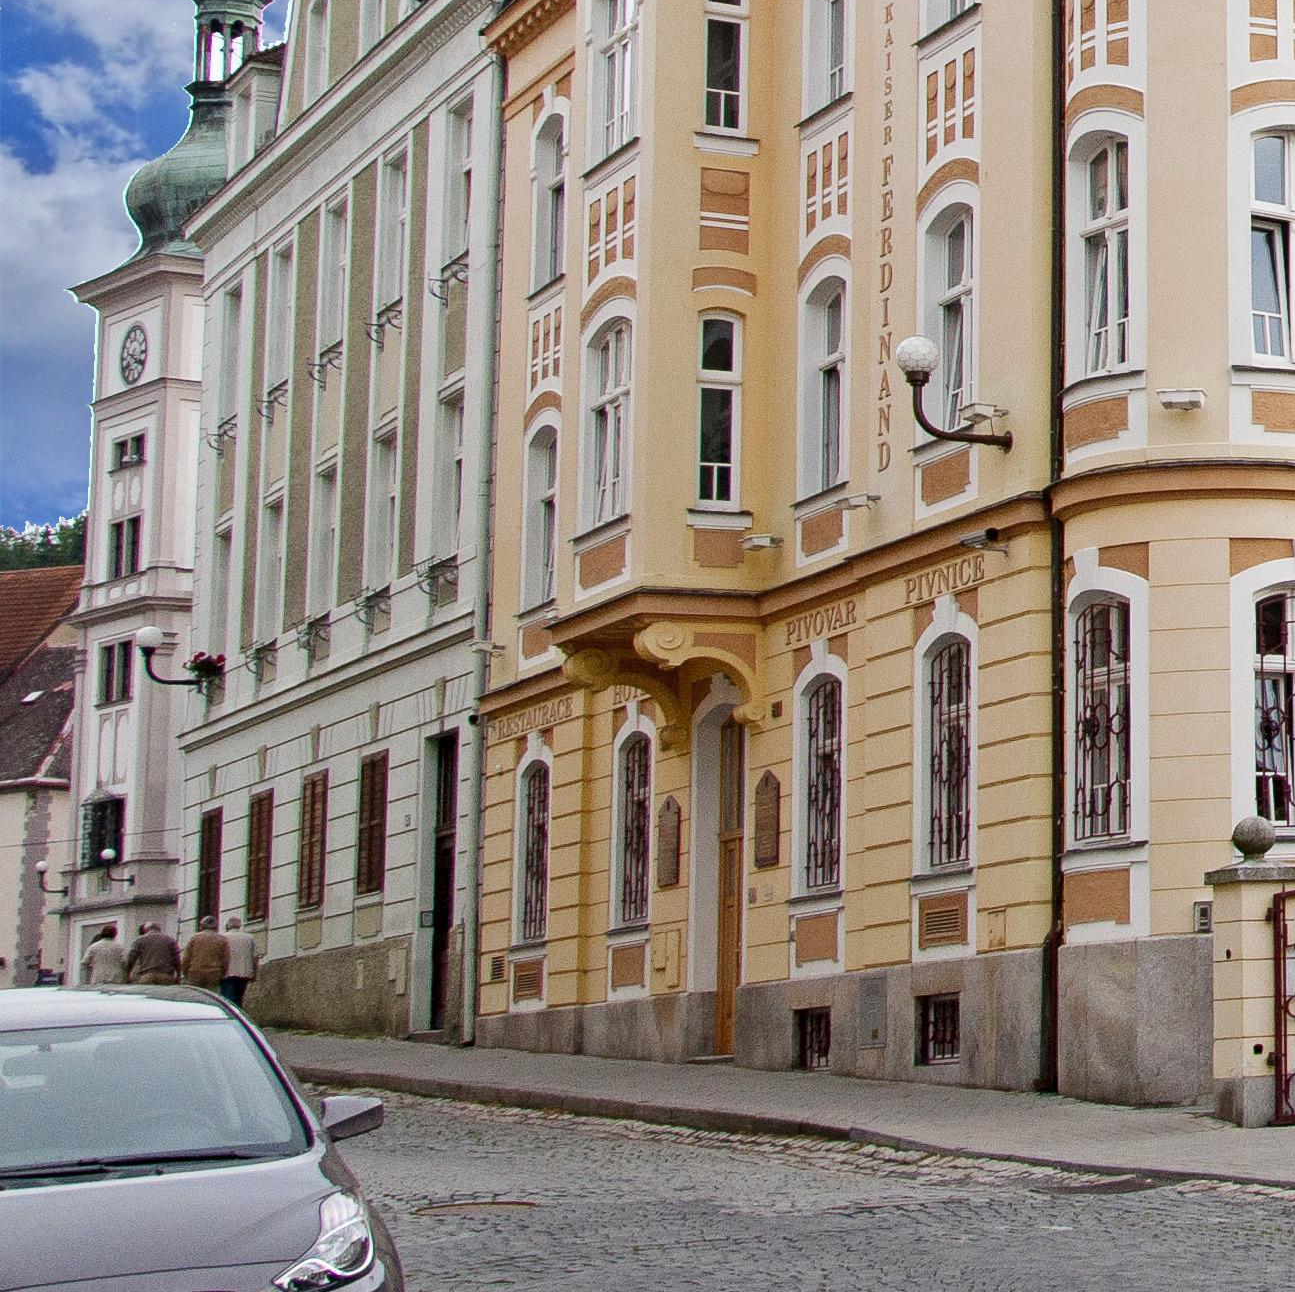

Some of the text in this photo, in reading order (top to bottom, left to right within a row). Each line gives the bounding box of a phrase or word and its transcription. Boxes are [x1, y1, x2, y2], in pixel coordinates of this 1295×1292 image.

[883, 3, 895, 146] KAISER
[877, 156, 894, 474] FERDINAND
[903, 553, 985, 605] PIVNICE
[785, 600, 857, 646] PIVOVAR
[497, 696, 573, 740] RESTAURACE
